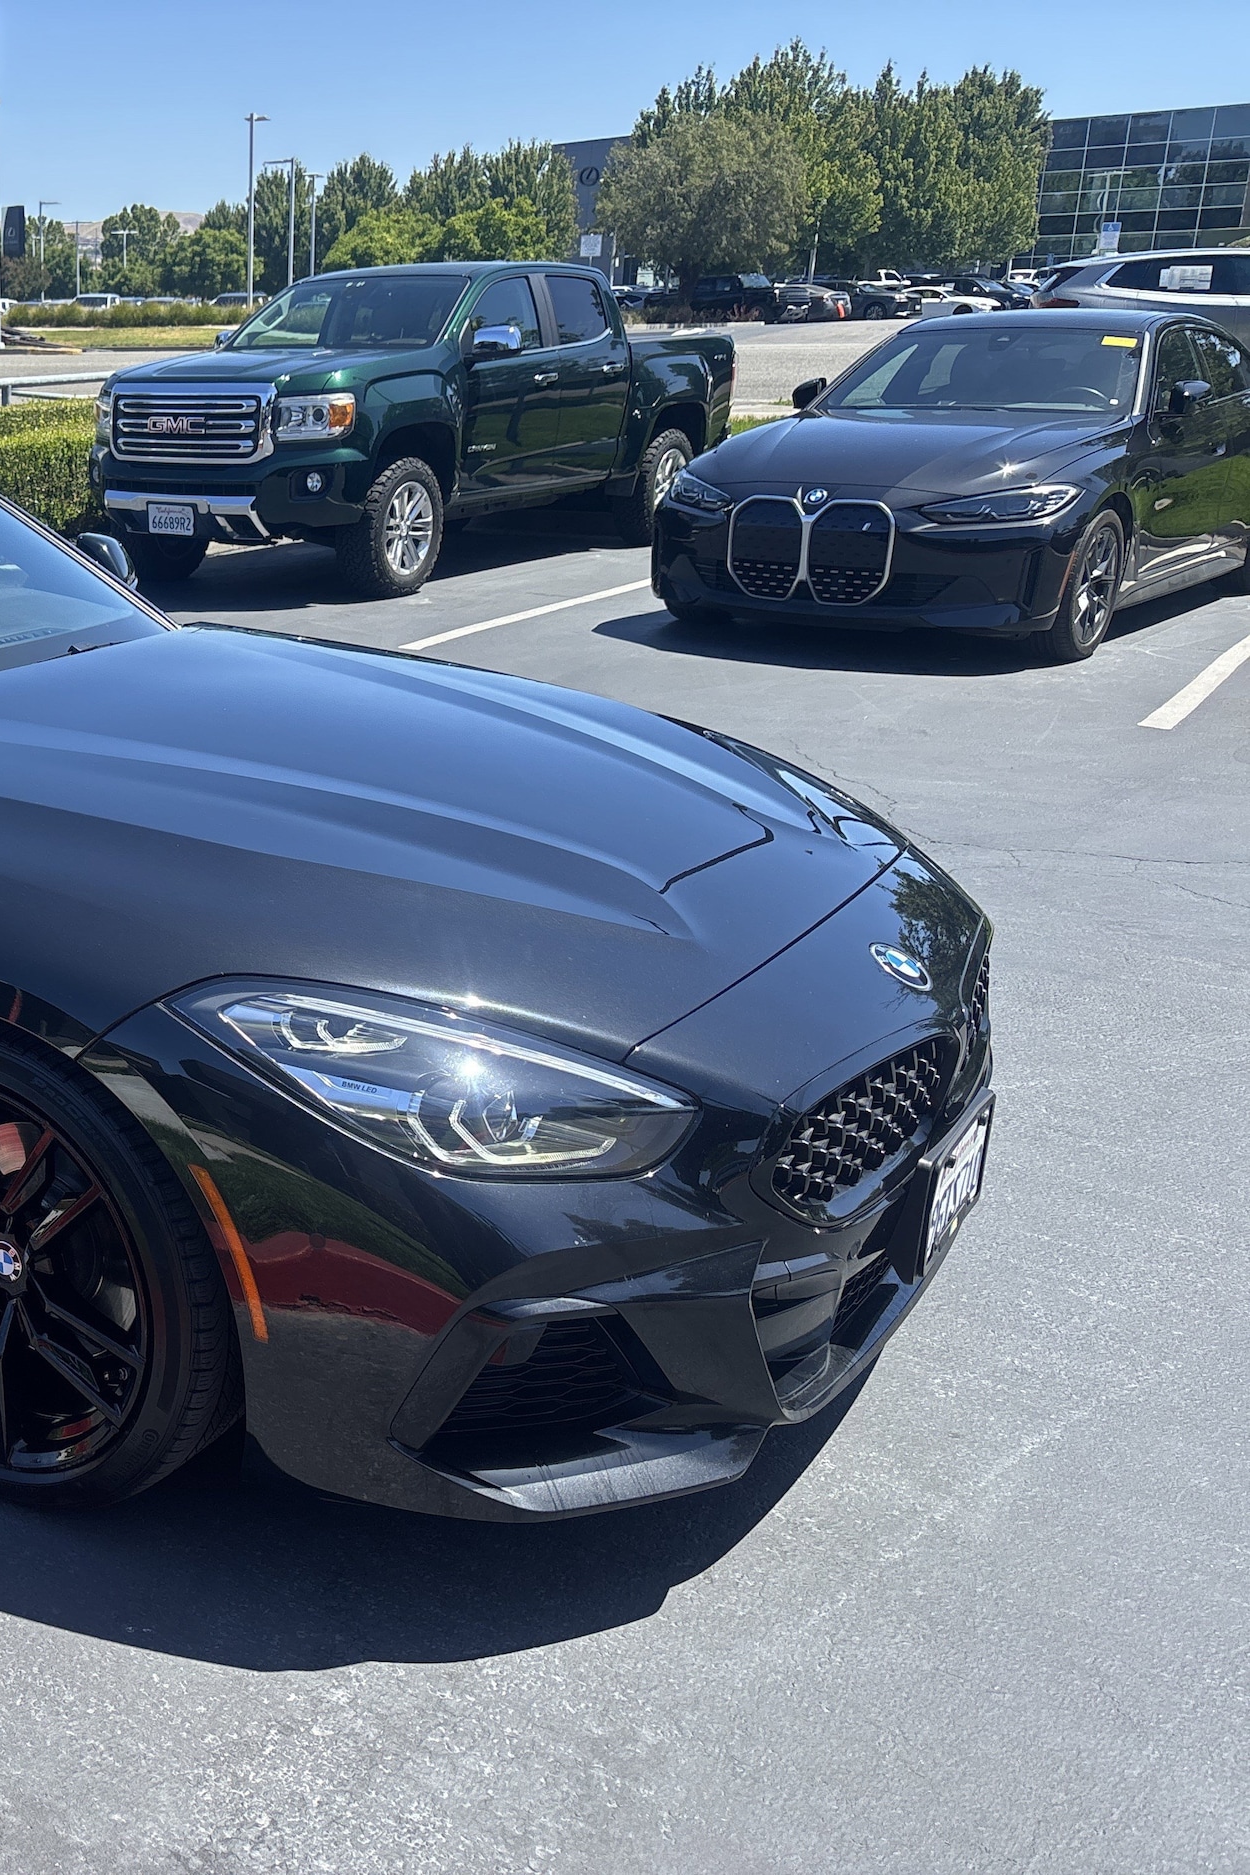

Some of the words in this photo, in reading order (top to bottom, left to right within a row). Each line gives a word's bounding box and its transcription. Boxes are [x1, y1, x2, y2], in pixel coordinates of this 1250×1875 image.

[147, 416, 206, 434] GMC
[152, 516, 191, 532] 66689R2
[341, 1080, 361, 1091] BMW
[361, 1083, 378, 1094] LED
[8, 1248, 21, 1282] BMW
